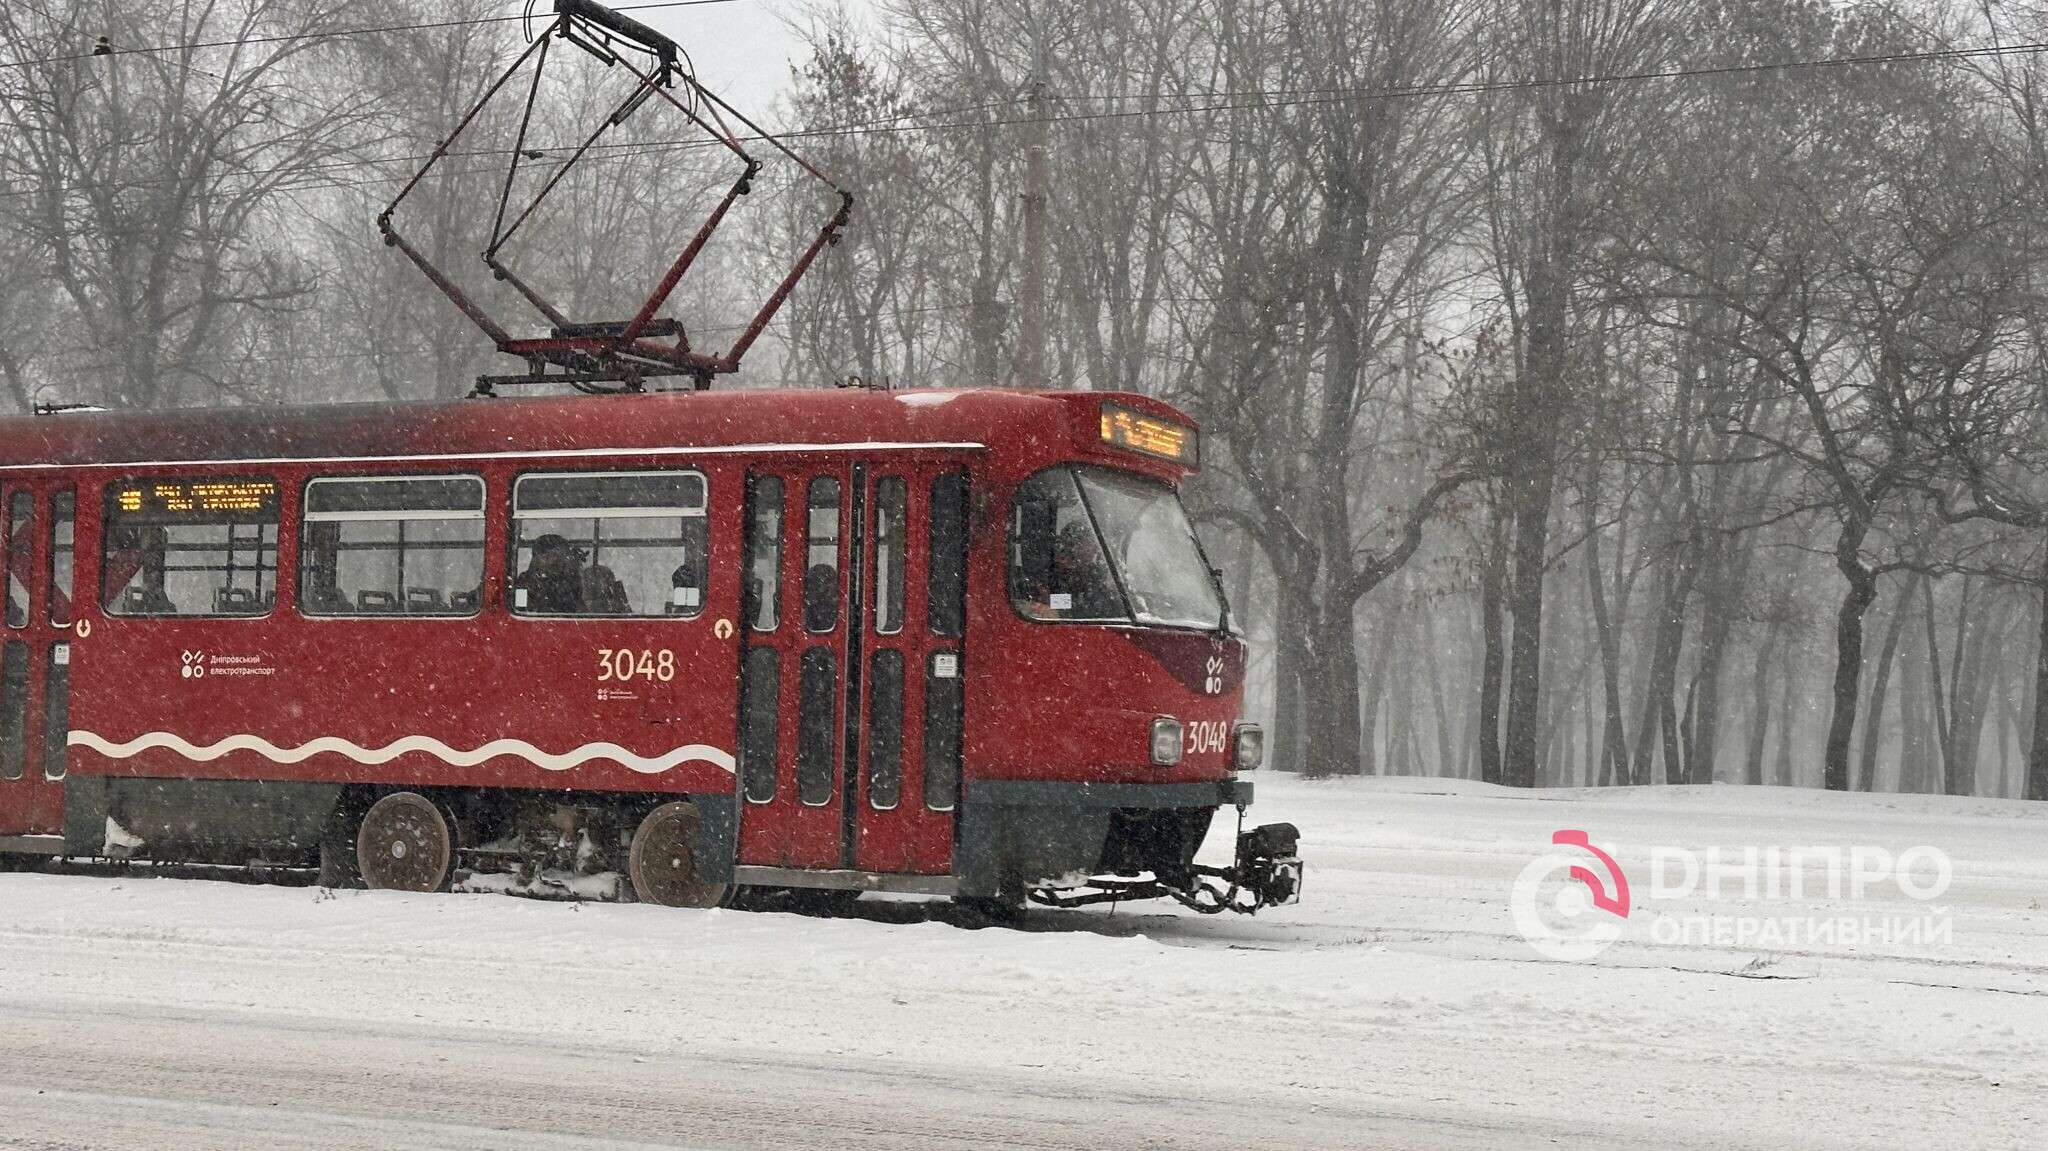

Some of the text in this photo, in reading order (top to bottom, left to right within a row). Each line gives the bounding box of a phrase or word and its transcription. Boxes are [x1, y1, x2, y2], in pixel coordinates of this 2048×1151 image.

[210, 655, 260, 664] Дніпровський
[597, 648, 675, 682] 3048
[1186, 720, 1227, 754] 3048
